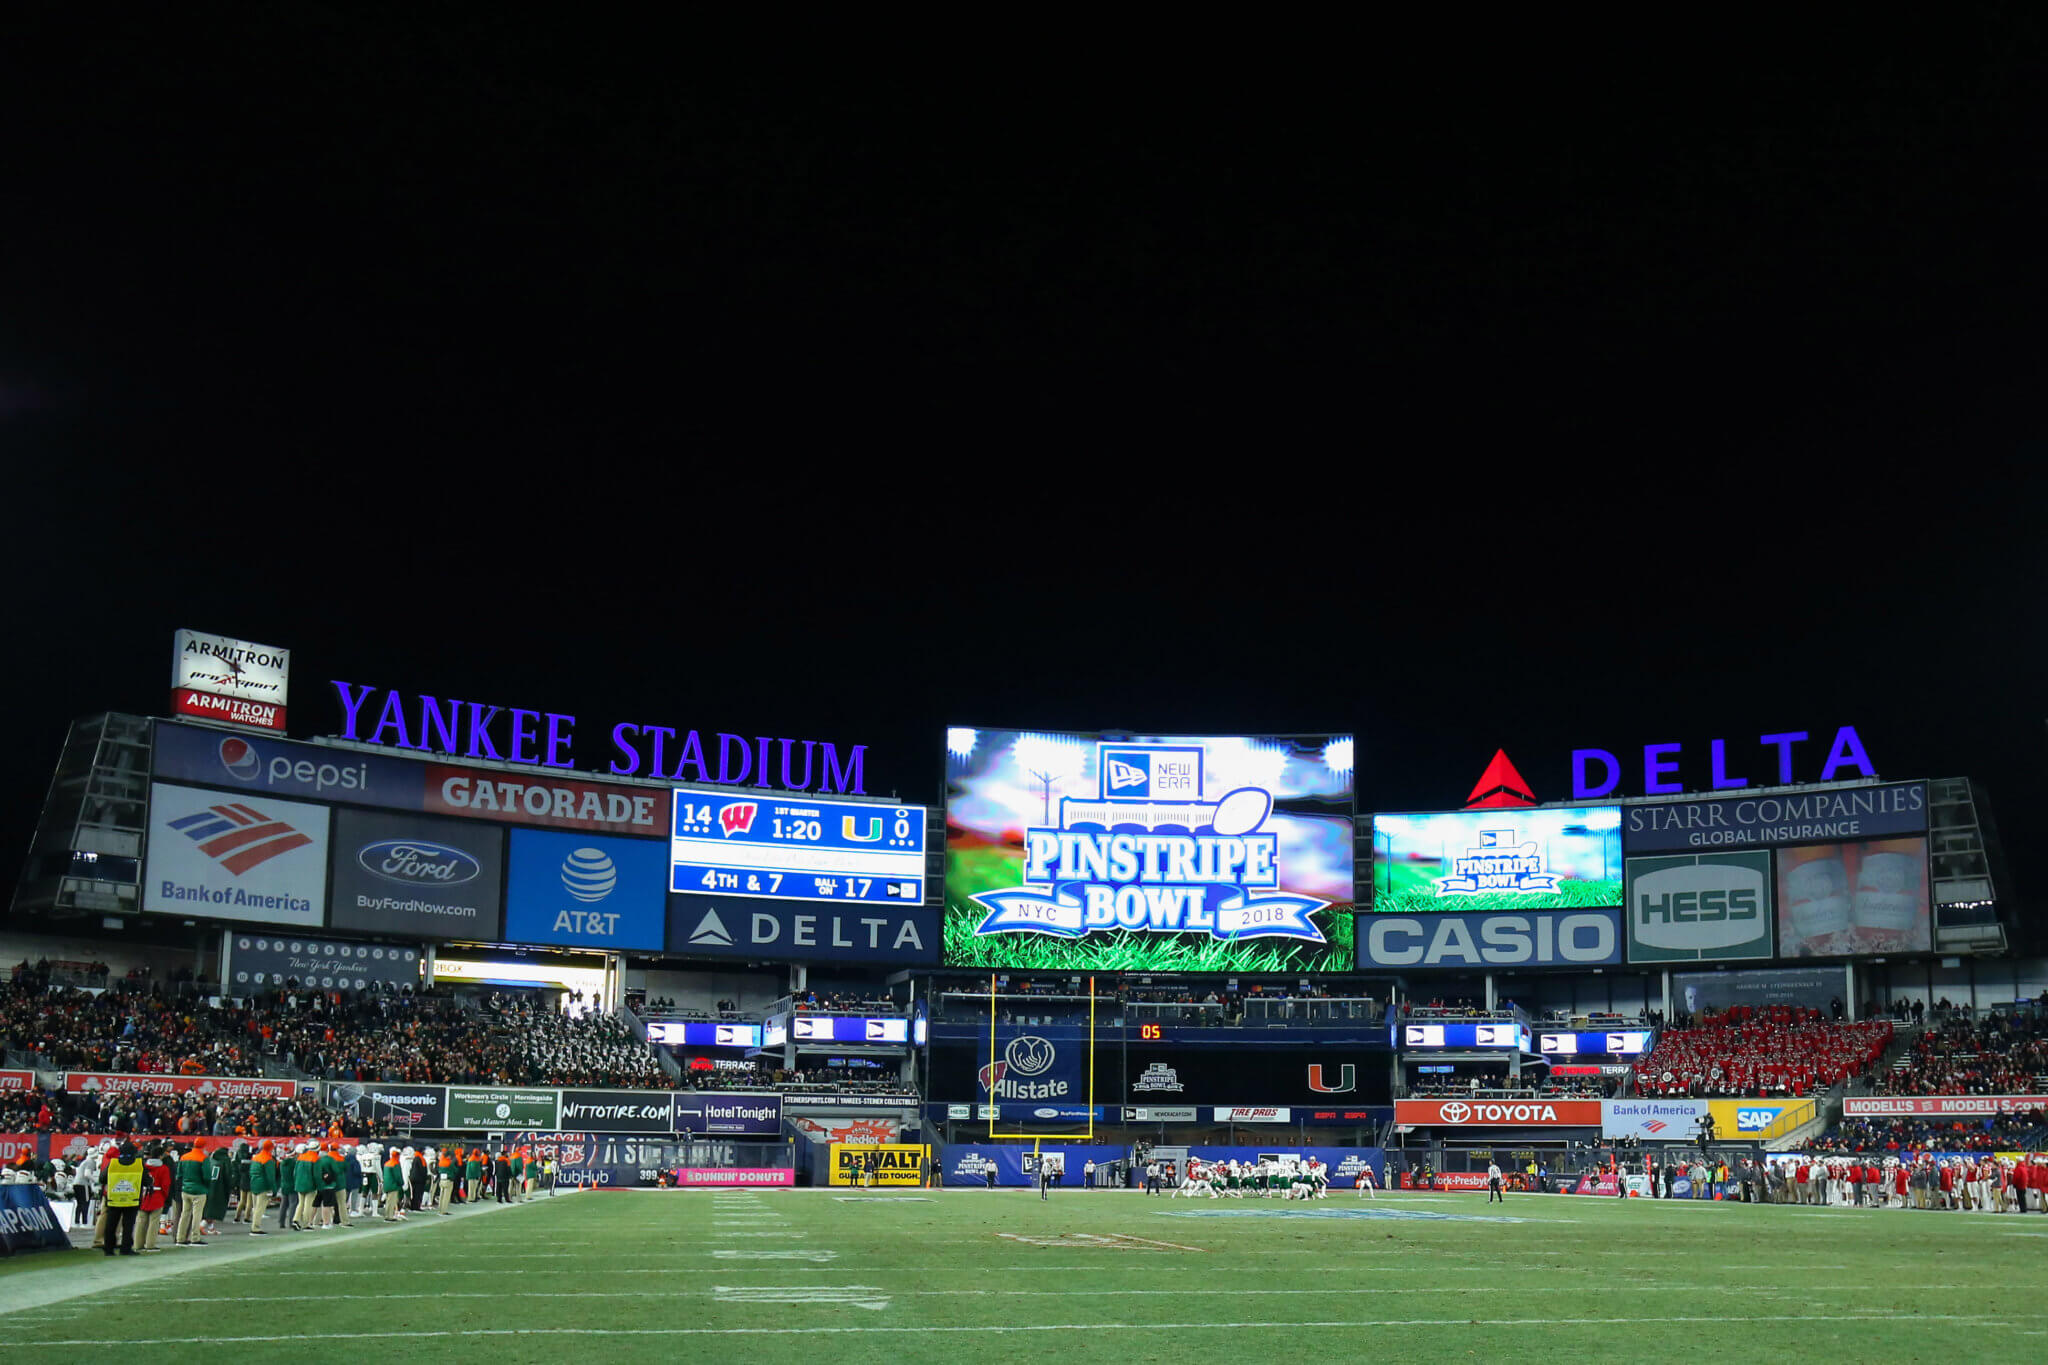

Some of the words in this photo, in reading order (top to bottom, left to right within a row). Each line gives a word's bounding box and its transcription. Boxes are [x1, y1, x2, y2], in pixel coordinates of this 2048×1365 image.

[186, 640, 284, 670] ARMITRON
[187, 693, 275, 718] ARMITRON
[230, 712, 273, 726] WATCHES
[330, 680, 576, 768] YANKEE
[610, 722, 868, 795] STADIUM
[1158, 762, 1190, 776] NEW
[1572, 726, 1875, 799] DELTA
[268, 756, 366, 791] pepsi
[1158, 776, 1190, 790] ERA
[442, 777, 654, 825] GATORADE
[1630, 802, 1724, 832] STARR
[1736, 786, 1923, 826] COMPANIES
[684, 804, 712, 825] 14
[772, 819, 822, 840] 1:20
[894, 819, 910, 838] 0
[1689, 828, 1756, 847] GLOBAL
[1760, 820, 1860, 841] INSURANCE
[382, 842, 456, 882] Ford
[1028, 832, 1276, 883] PINSTRIPE
[1457, 857, 1540, 876] PINSTRIPE
[702, 870, 738, 890] 4TH
[747, 875, 760, 891] &
[768, 874, 784, 893] 7
[814, 877, 838, 888] BALL
[818, 886, 834, 896] ON
[845, 878, 872, 898] 17
[1478, 874, 1520, 888] BOWL
[161, 881, 208, 904] Bank
[210, 888, 234, 904] of
[234, 889, 310, 912] America
[1640, 888, 1757, 925] HESS
[358, 896, 476, 918] BuyFordNow.com
[1018, 904, 1057, 922] NYC
[1085, 886, 1215, 930] BOWL
[1242, 908, 1284, 926] 2018
[553, 910, 620, 936] AT&T
[751, 912, 924, 951] DELTA
[1368, 914, 1616, 965] CASIO
[1142, 1025, 1160, 1040] 05
[0, 1077, 22, 1088] rm
[993, 1079, 1068, 1099] Allstate
[372, 1092, 436, 1106] Panasonic
[1850, 1100, 1914, 1112] MODELL'S
[562, 1102, 670, 1122] NITTOTIRE.COM
[1229, 1108, 1252, 1120] TIRE
[1250, 1108, 1278, 1120] PROS
[1474, 1104, 1557, 1121] TOYOTA
[1614, 1104, 1640, 1116] Bank
[1641, 1104, 1651, 1116] of
[1652, 1104, 1696, 1116] America
[1738, 1112, 1774, 1128] SAP
[464, 1117, 481, 1126] What
[557, 1169, 609, 1184] tubHub
[695, 1172, 738, 1182] DUNKIN'
[739, 1172, 785, 1182] DONUTS
